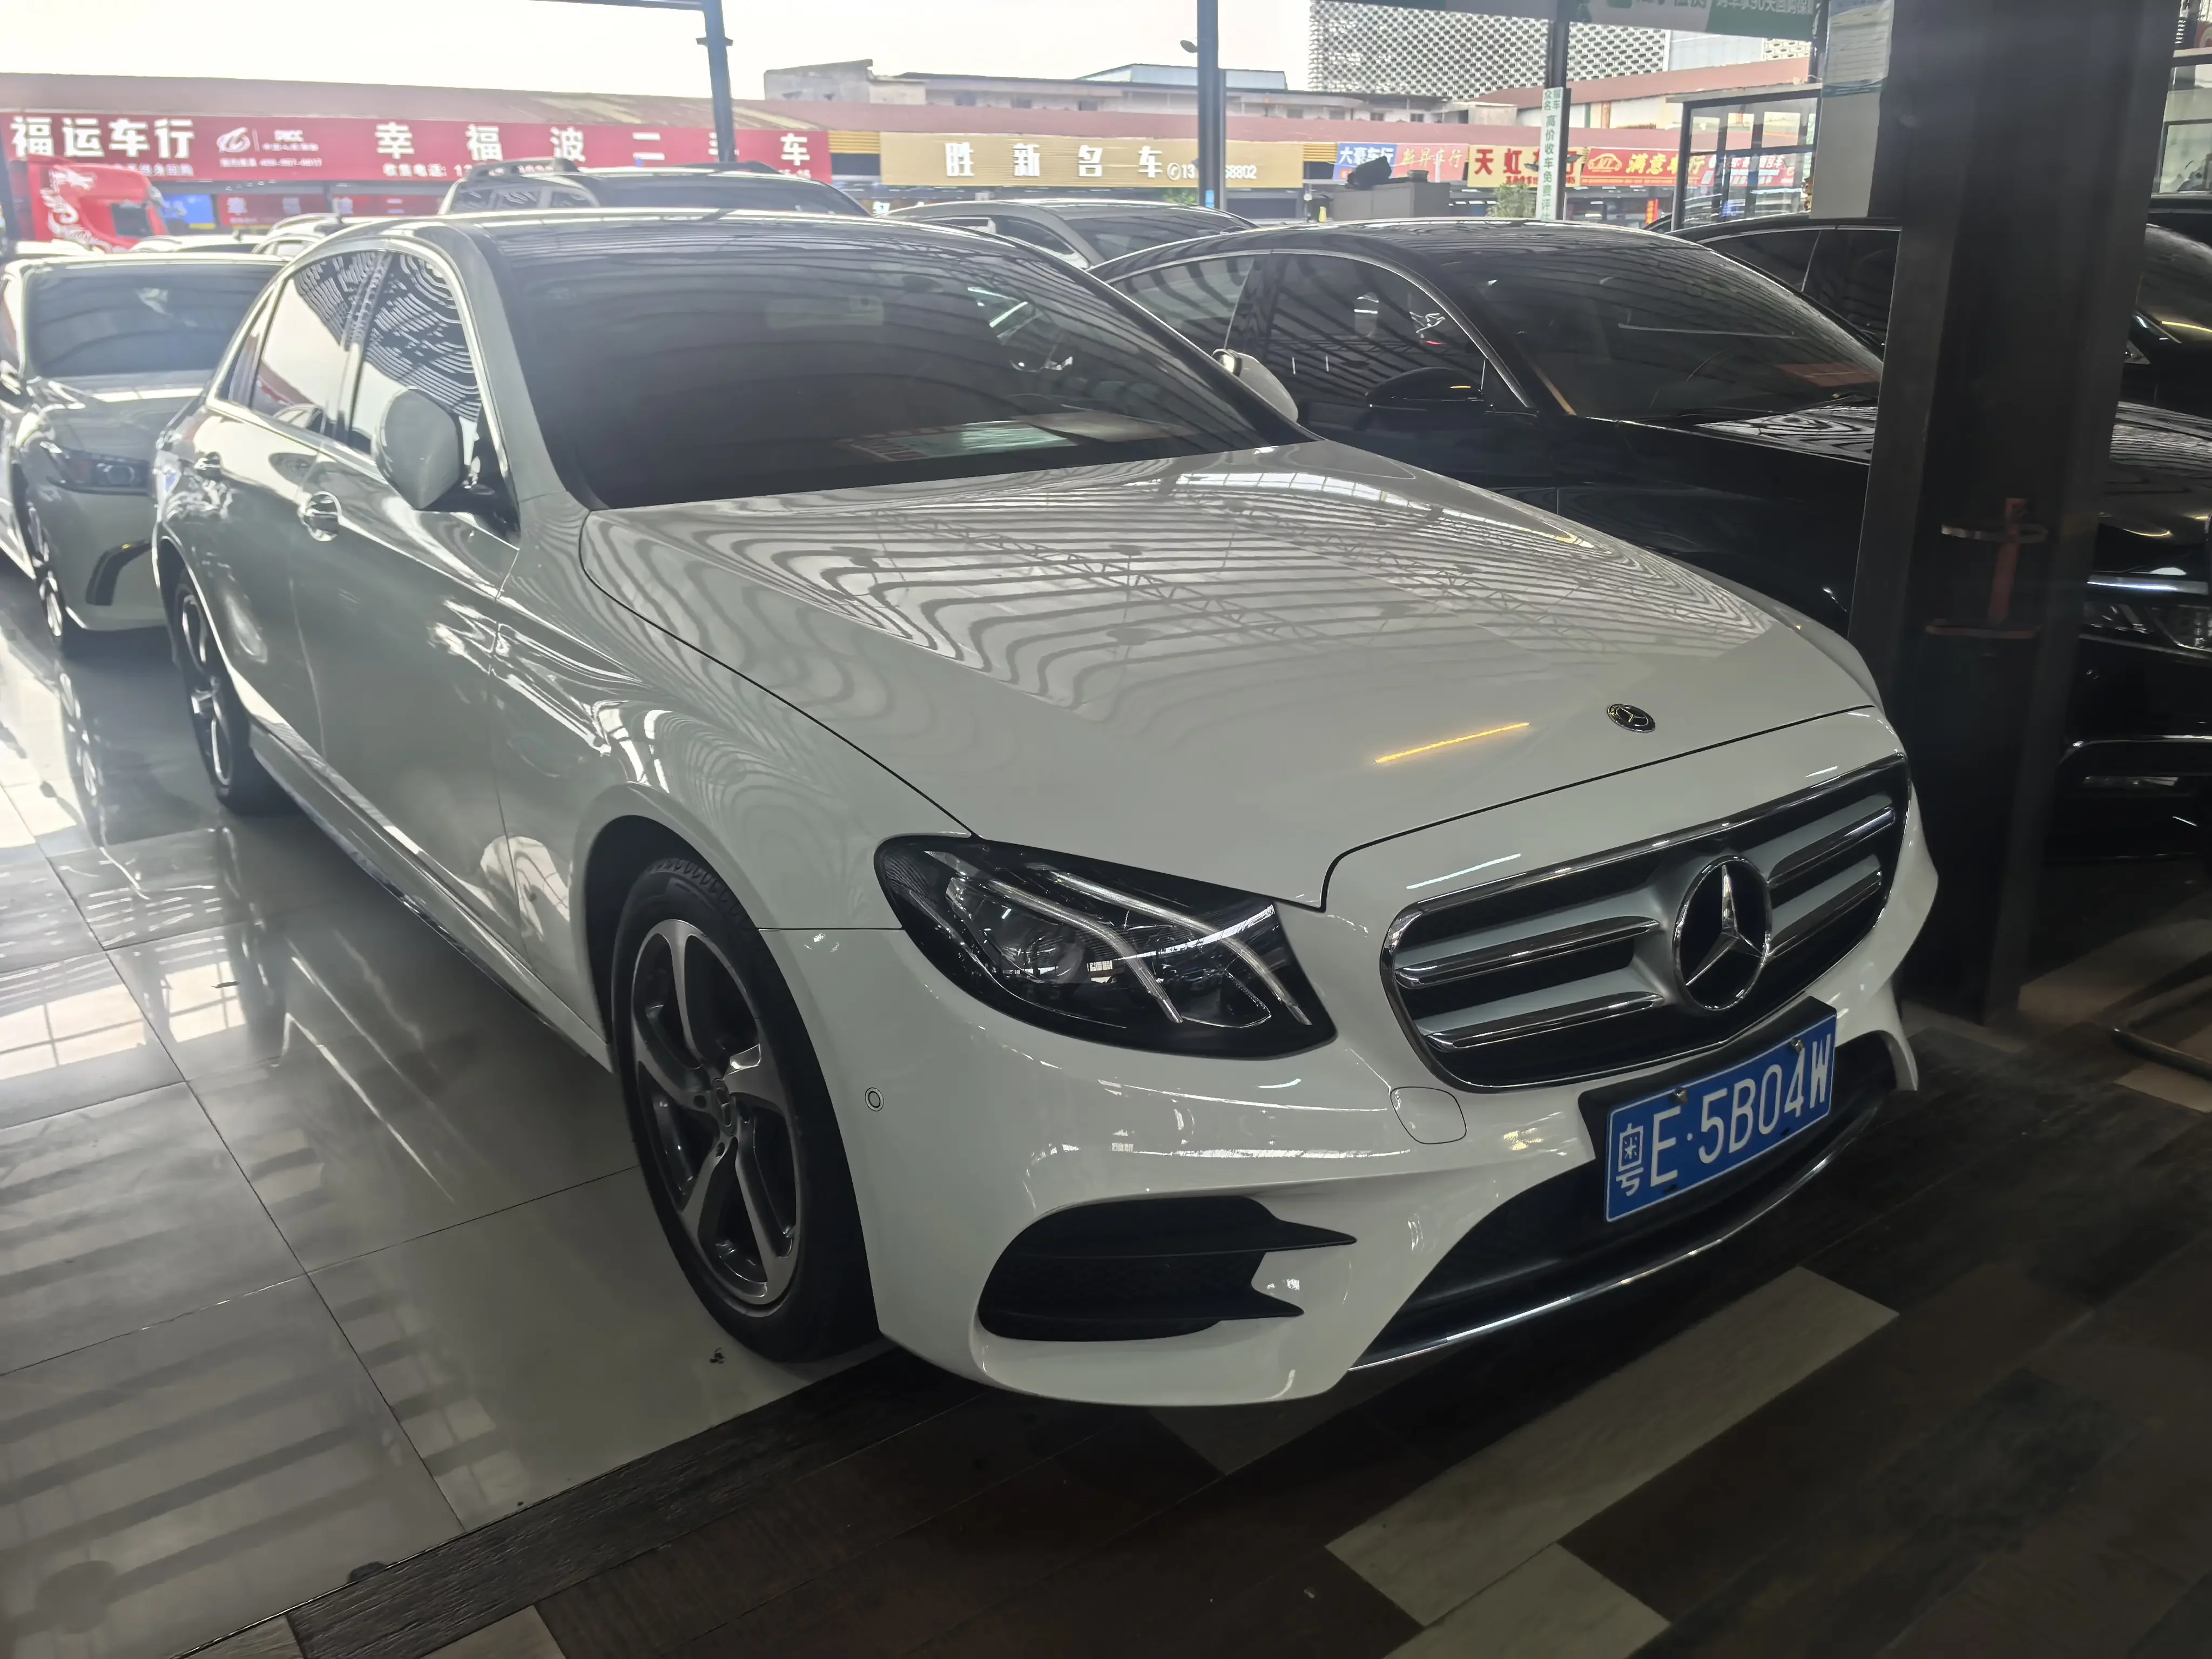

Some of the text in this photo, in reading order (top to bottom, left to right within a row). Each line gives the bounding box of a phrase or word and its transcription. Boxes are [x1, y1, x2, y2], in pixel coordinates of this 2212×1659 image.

[10, 116, 195, 161] 福运车行
[1474, 148, 1577, 175] 天虹
